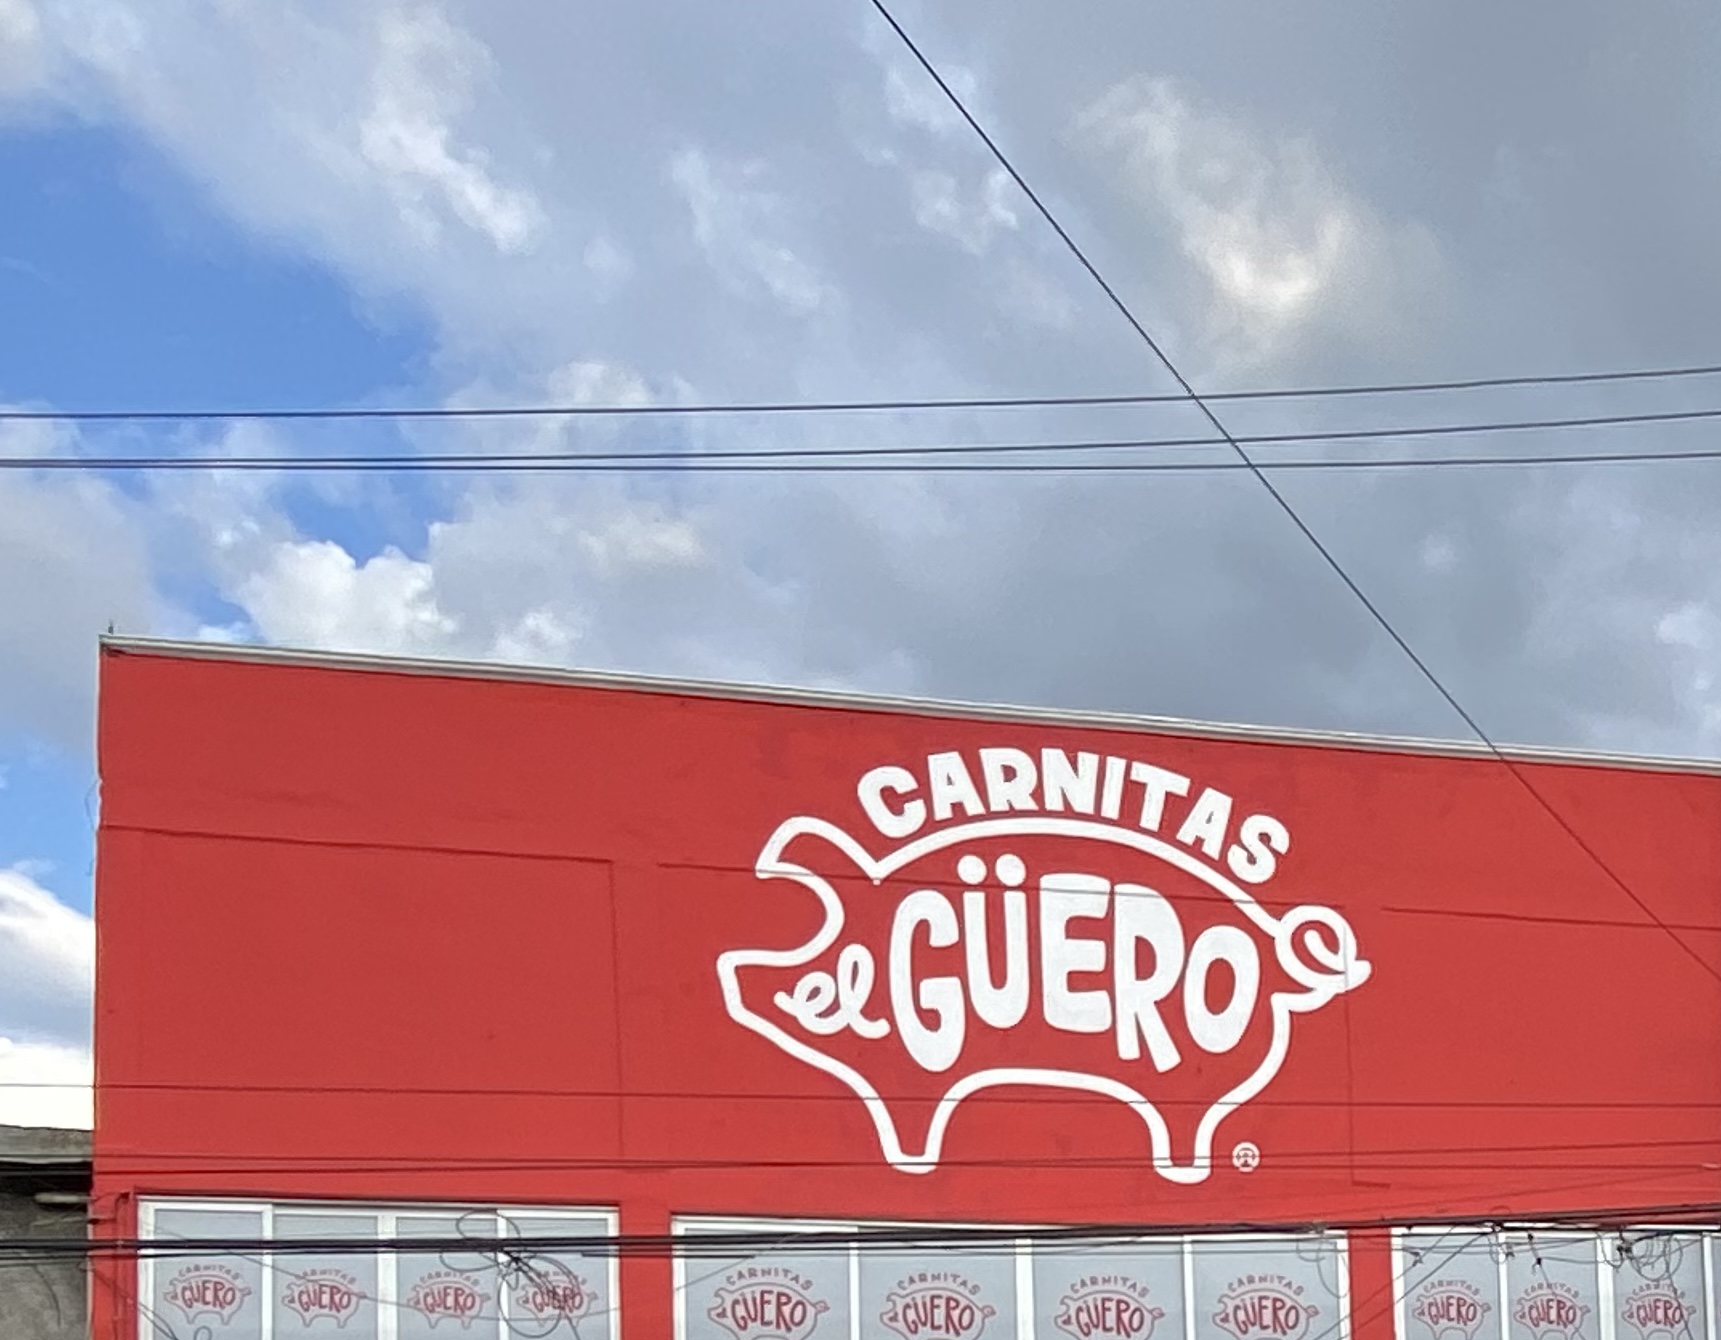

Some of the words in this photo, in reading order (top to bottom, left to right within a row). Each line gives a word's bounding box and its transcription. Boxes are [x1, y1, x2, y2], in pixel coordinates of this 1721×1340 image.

[857, 747, 1290, 884] CARNITAS
[774, 943, 890, 1039] el
[889, 853, 1260, 1072] GÜERO
[726, 1267, 813, 1291] CARNITAS
[897, 1272, 981, 1295] CARNITAS
[1070, 1276, 1149, 1298] CARNITAS
[1228, 1275, 1304, 1295] CARNITAS
